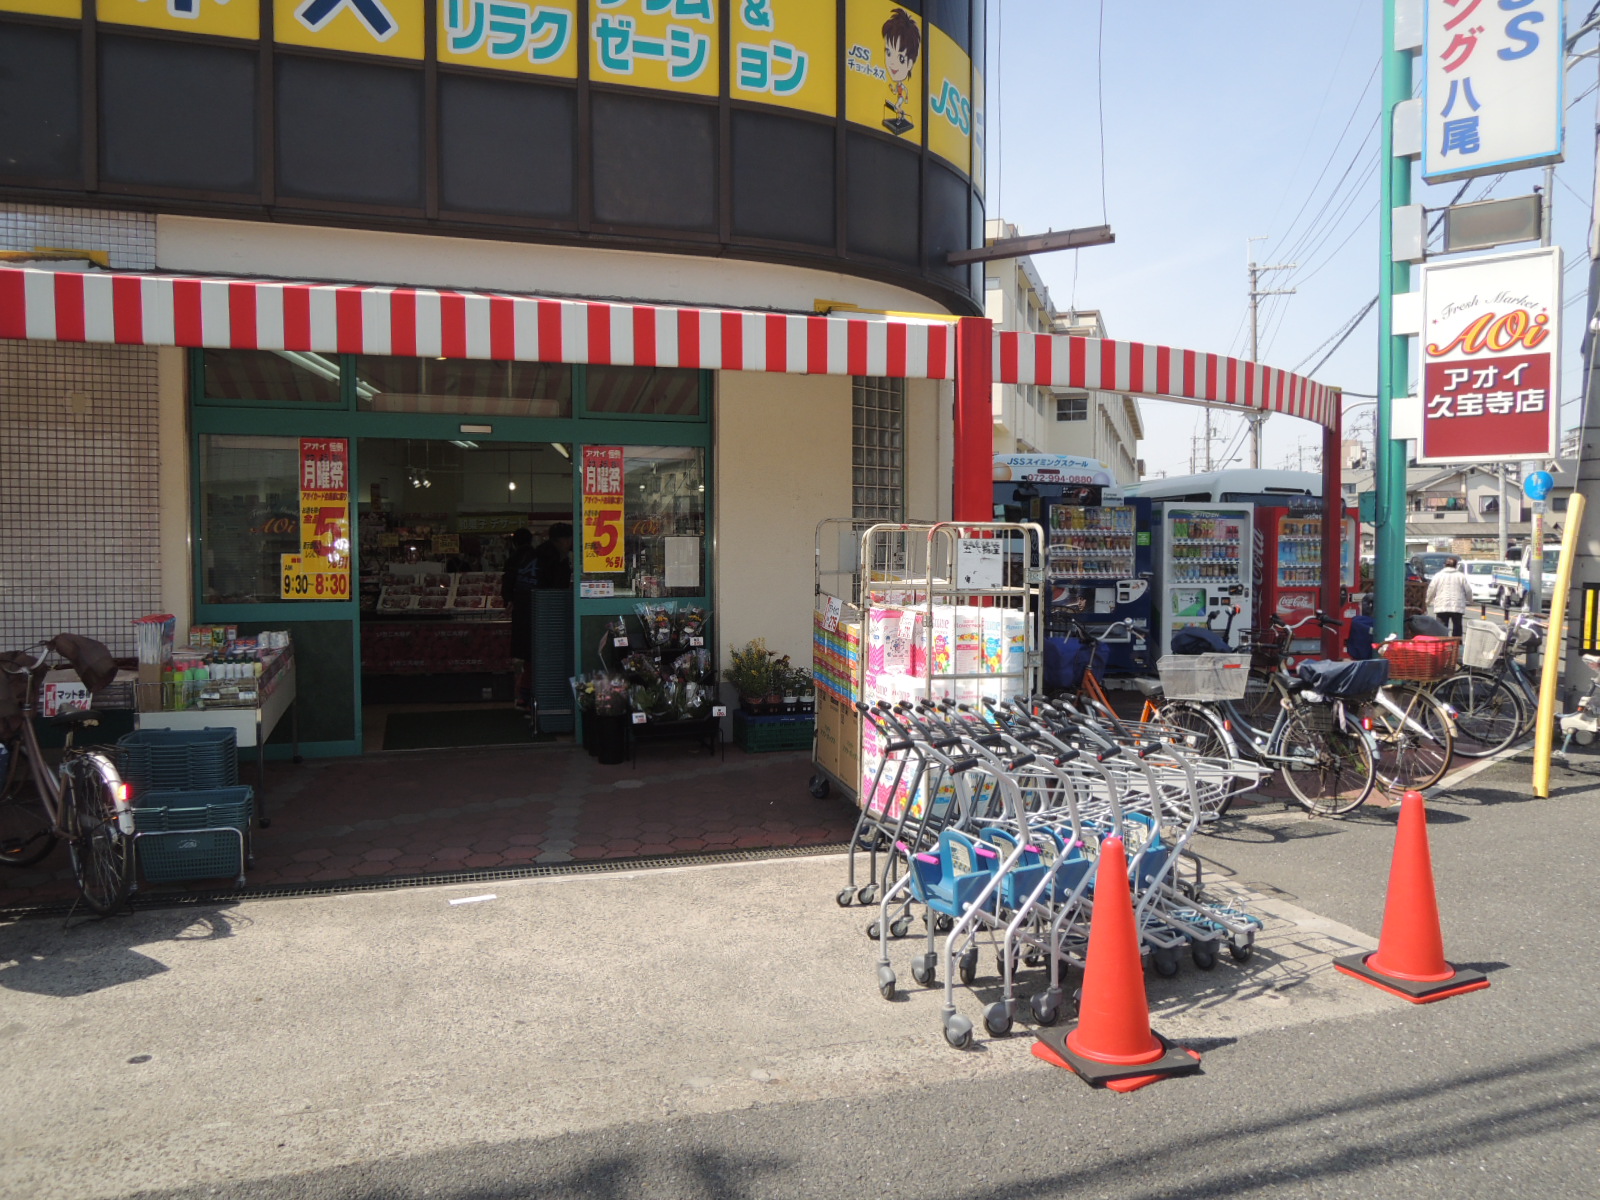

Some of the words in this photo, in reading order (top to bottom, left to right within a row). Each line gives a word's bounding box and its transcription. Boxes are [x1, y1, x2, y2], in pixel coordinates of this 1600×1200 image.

[849, 45, 870, 60] JSS
[931, 80, 970, 136] JSS
[1441, 294, 1479, 321] Fresh
[1485, 290, 1539, 310] Market
[1443, 362, 1529, 391] アオイ
[1427, 388, 1545, 419] 久宝寺店
[304, 460, 344, 489] 月曜祭
[586, 466, 621, 493] 月曜祭
[593, 510, 622, 557] 5
